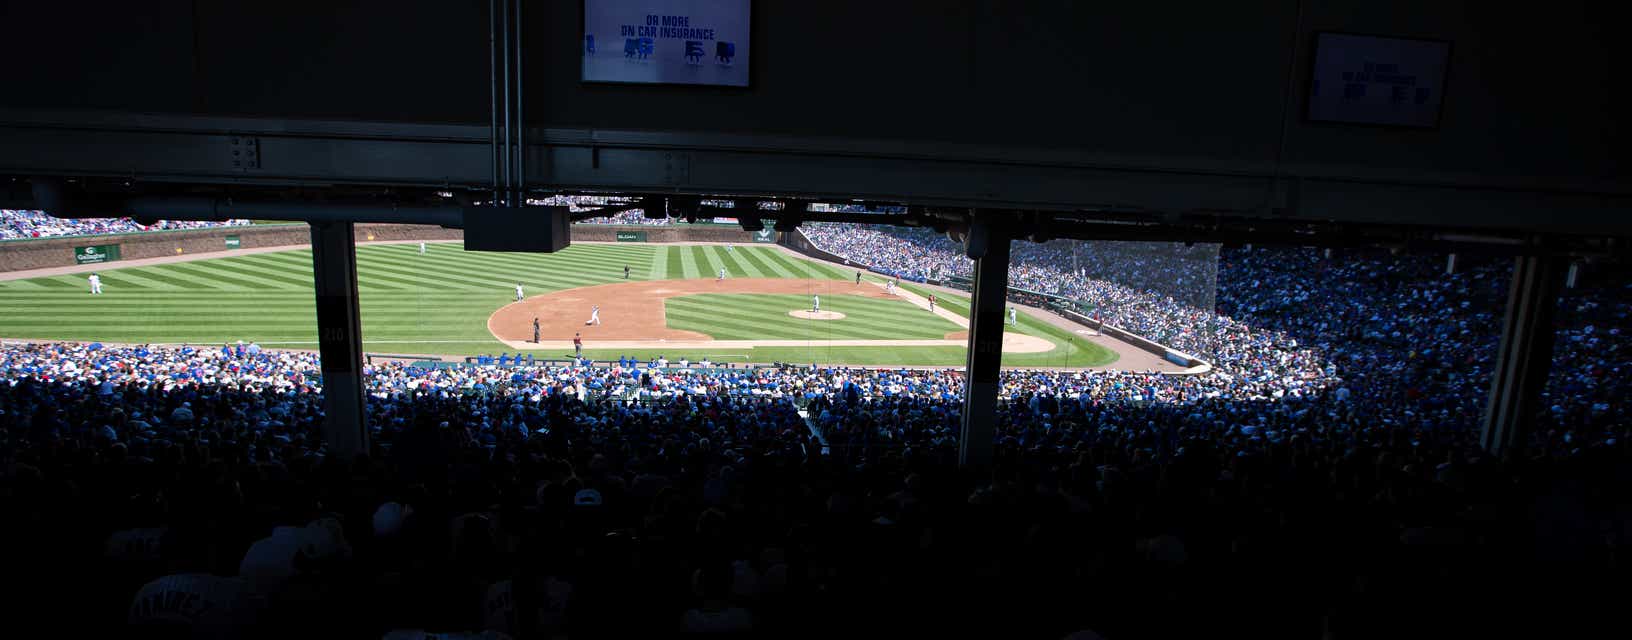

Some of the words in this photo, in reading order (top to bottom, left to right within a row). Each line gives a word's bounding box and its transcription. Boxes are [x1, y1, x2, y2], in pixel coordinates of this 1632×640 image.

[646, 14, 659, 26] OR
[662, 15, 689, 28] MORE
[621, 25, 635, 37] ON
[638, 26, 657, 38] CAR
[660, 27, 715, 41] INSURANCE
